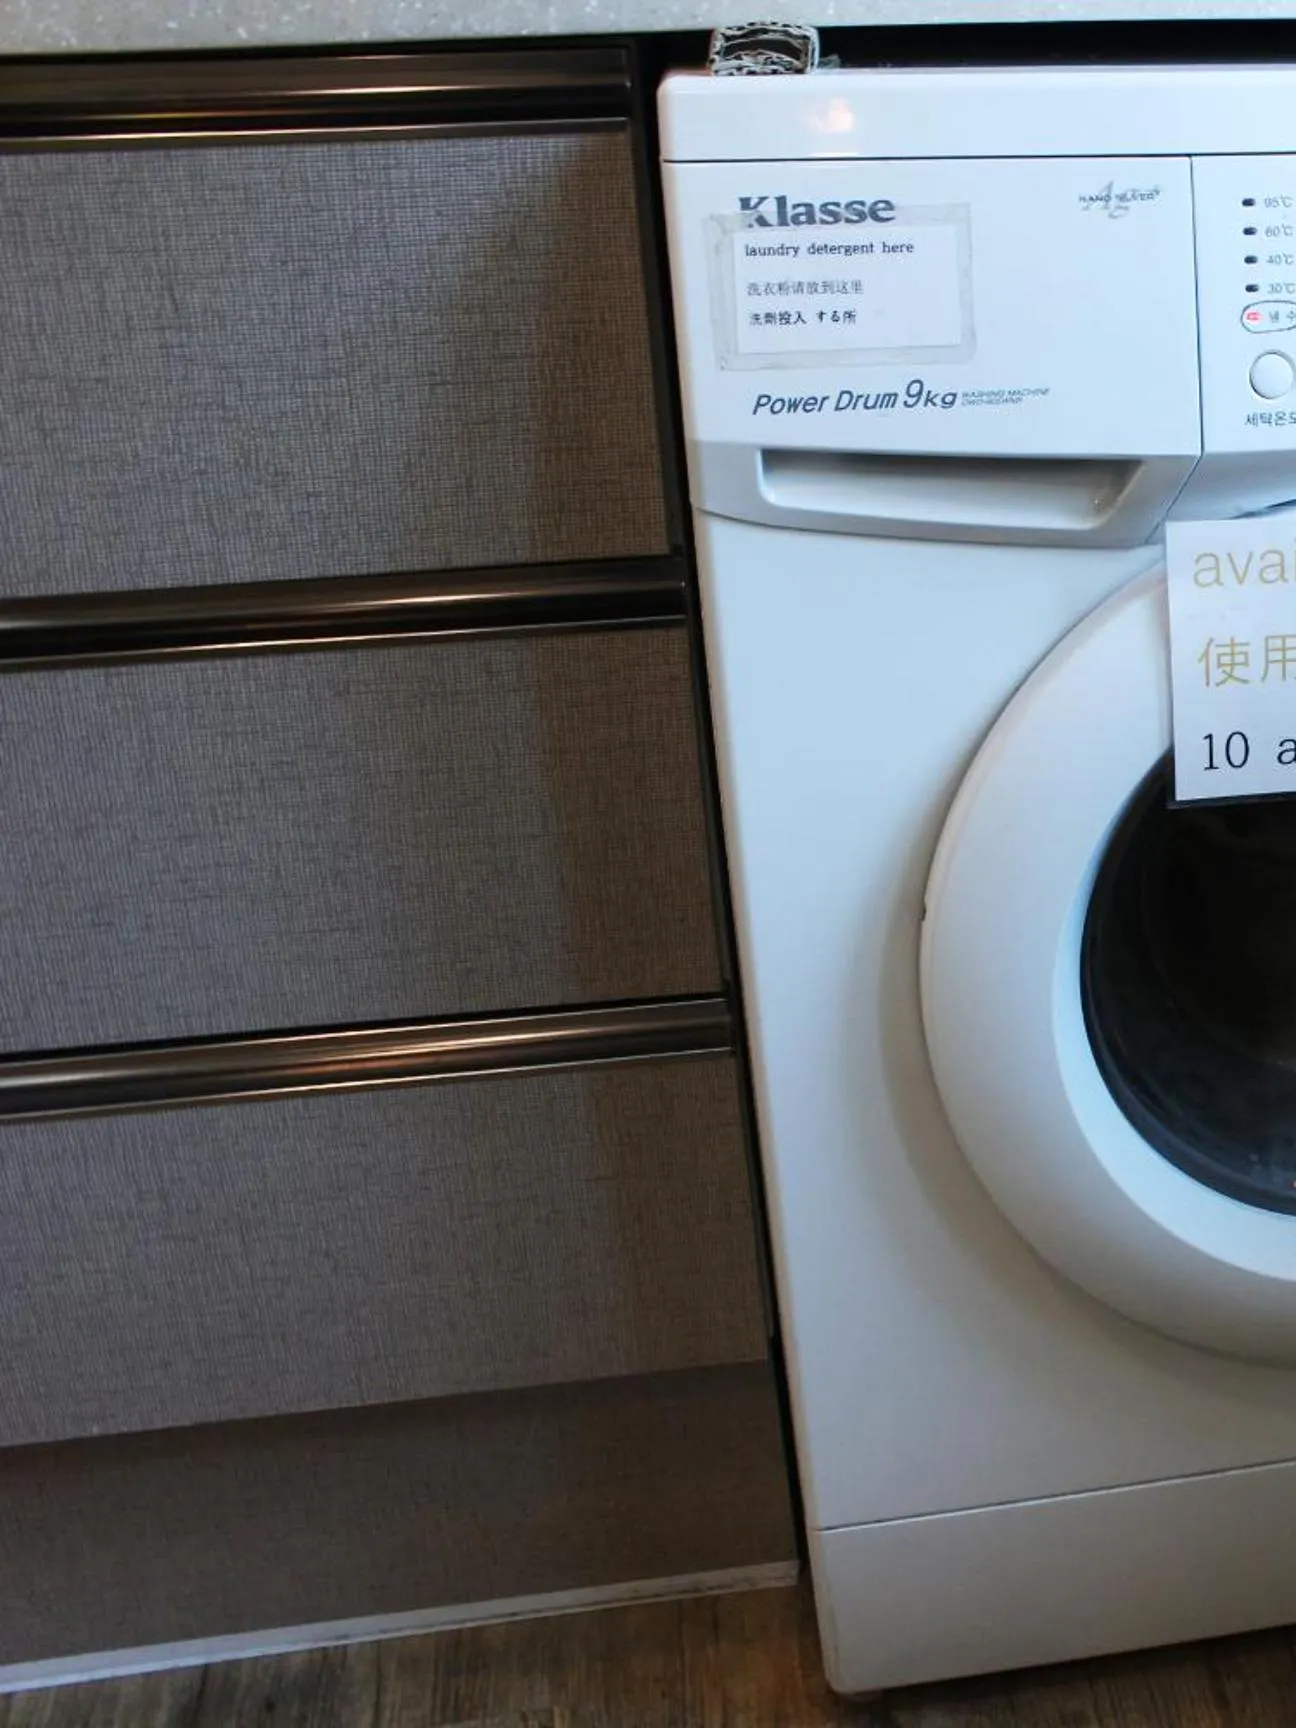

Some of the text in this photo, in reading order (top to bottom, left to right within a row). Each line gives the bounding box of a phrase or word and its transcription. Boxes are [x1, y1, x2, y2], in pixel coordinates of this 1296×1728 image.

[738, 194, 896, 229] Klasse
[744, 240, 915, 259] laundry detergent here
[751, 392, 830, 416] Power
[833, 389, 899, 413] Drum
[902, 378, 959, 411] 9kg
[1201, 730, 1250, 771] 10
